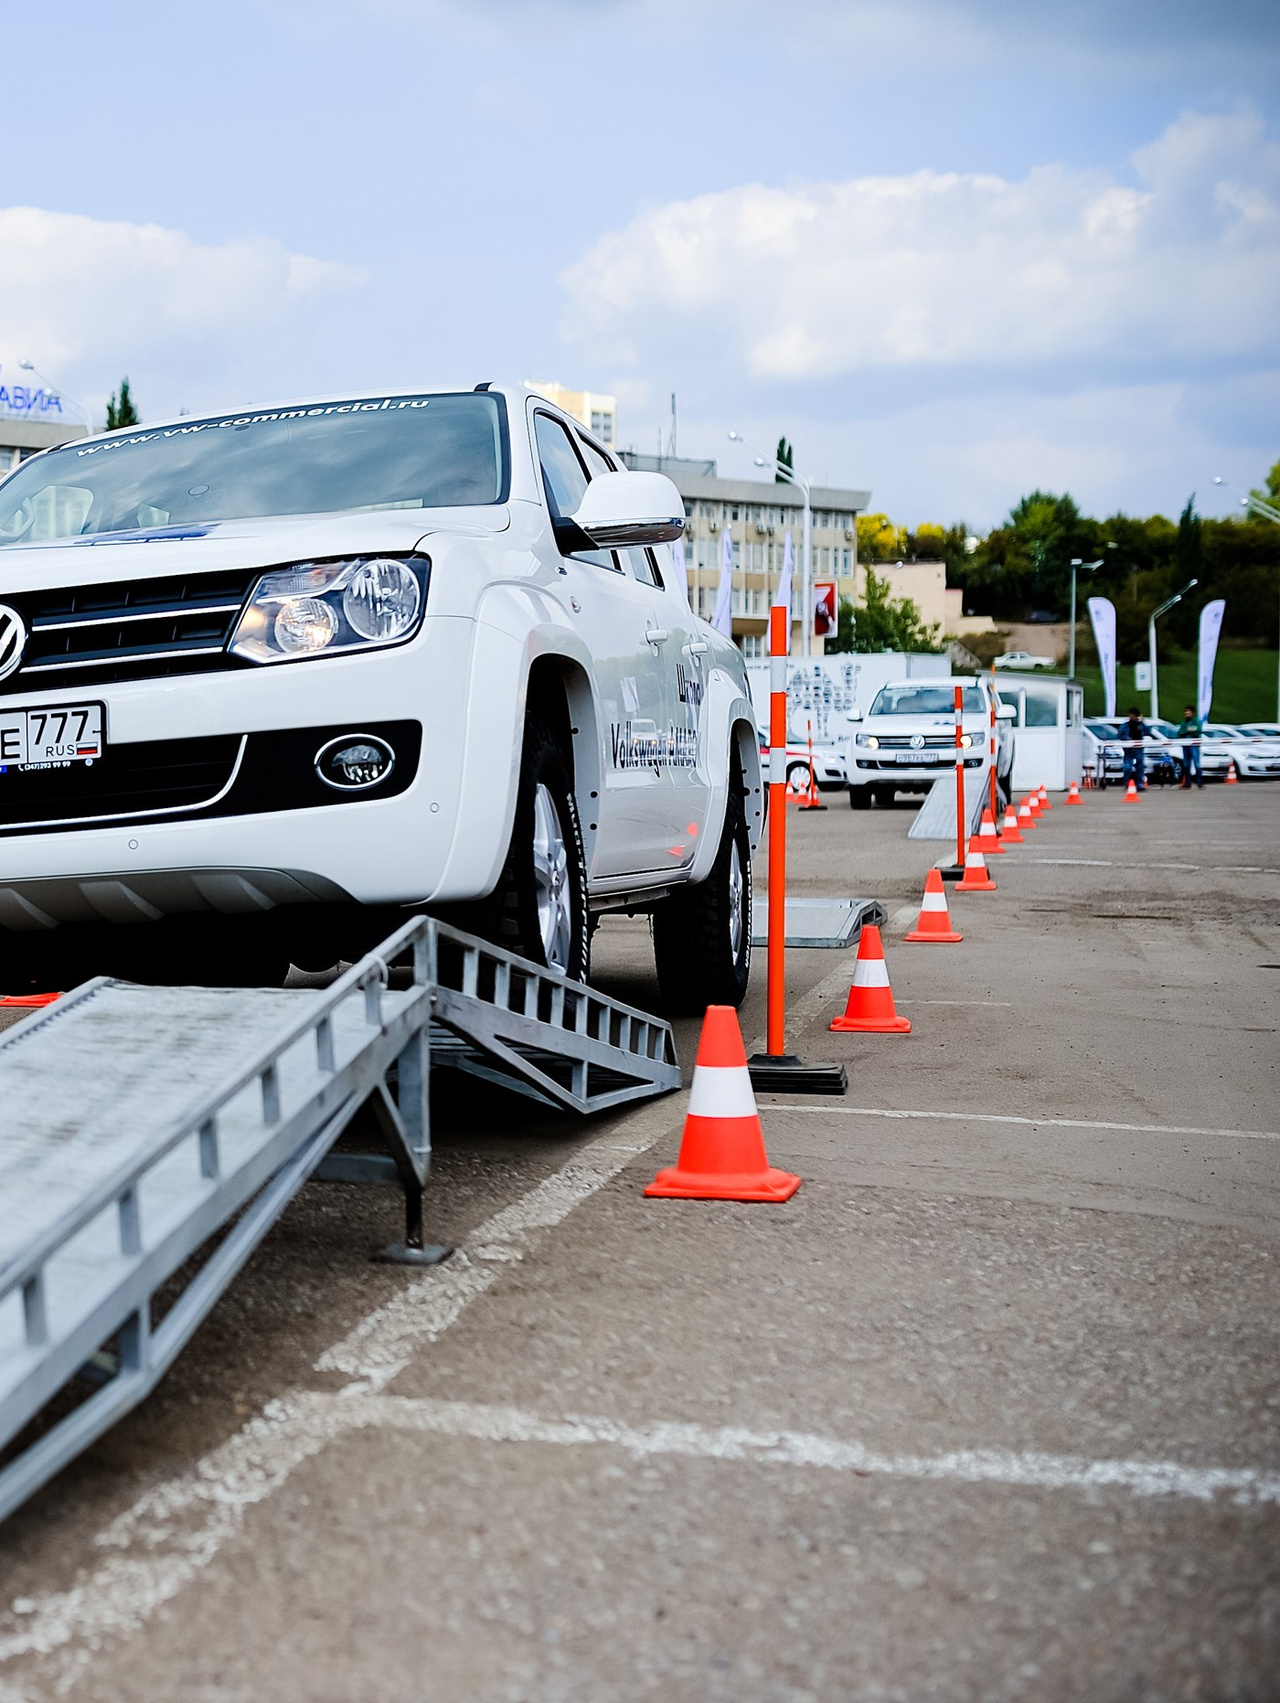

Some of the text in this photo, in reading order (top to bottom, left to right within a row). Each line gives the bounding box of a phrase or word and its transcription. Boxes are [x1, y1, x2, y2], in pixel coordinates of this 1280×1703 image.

[77, 398, 429, 457] www.vw-commercial.ru
[30, 710, 89, 745] 777
[611, 721, 667, 777] Volkswagen
[46, 744, 75, 757] RUS
